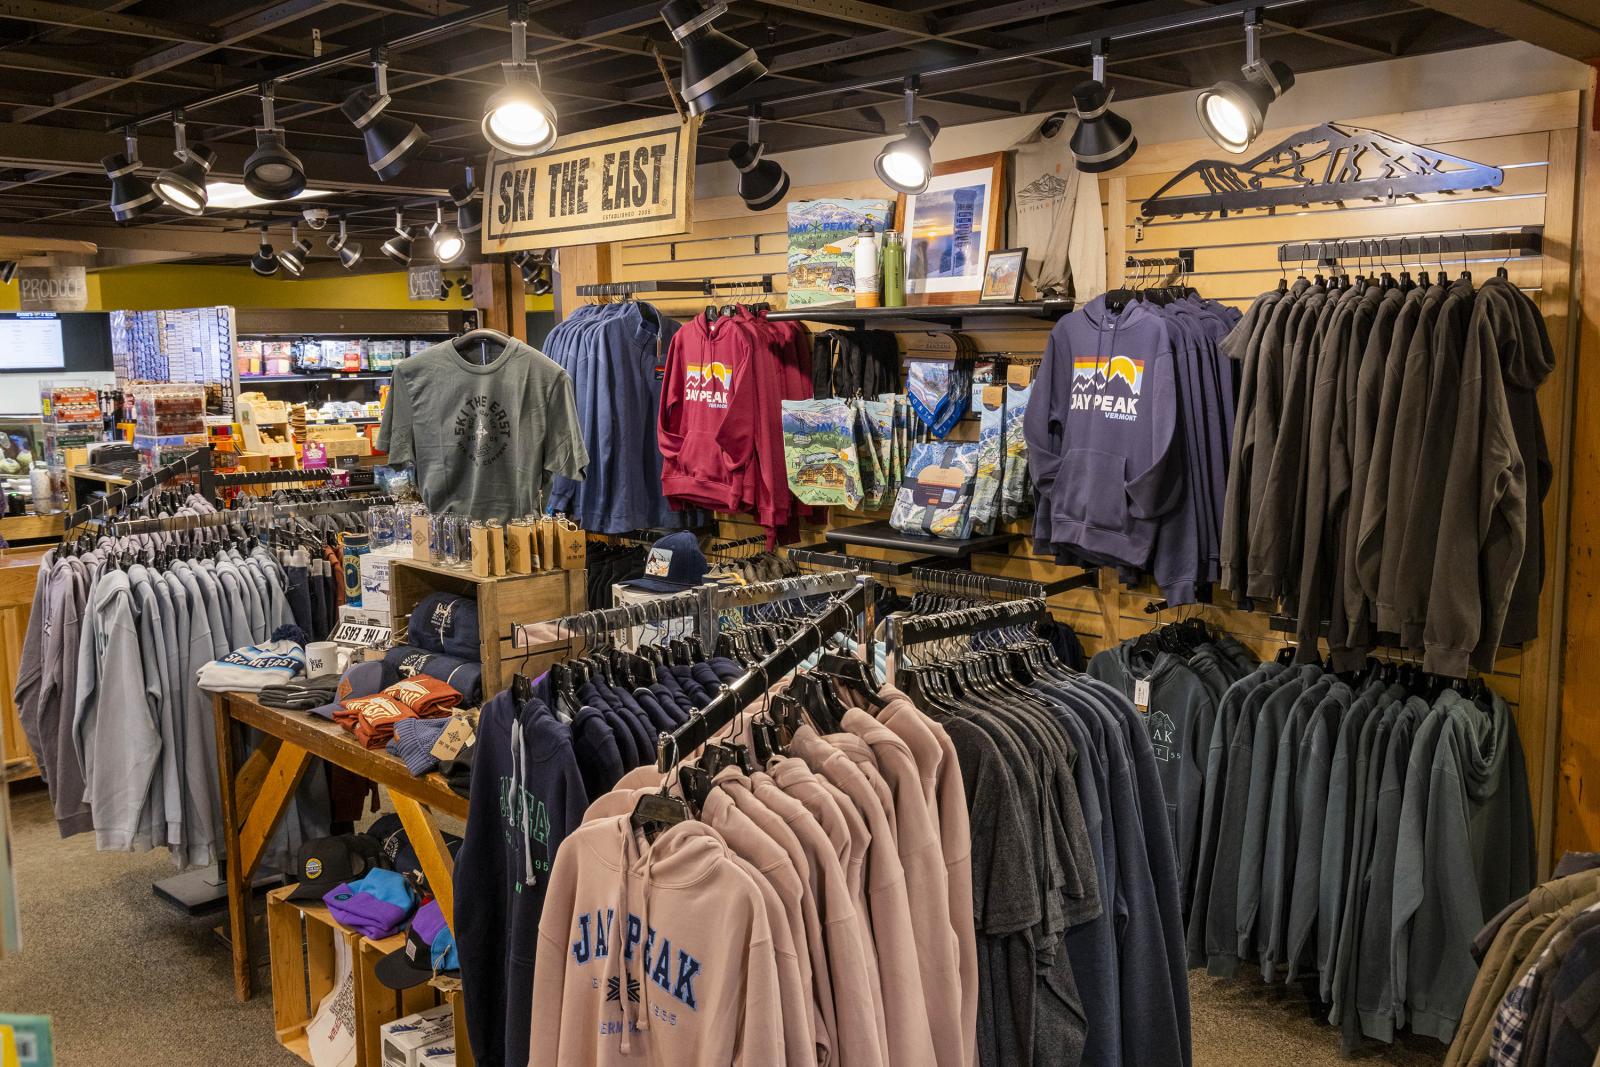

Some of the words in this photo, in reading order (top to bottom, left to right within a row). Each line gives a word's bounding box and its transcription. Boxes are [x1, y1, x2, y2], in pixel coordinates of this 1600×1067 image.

[498, 167, 537, 224] SKI
[548, 157, 590, 217] THE
[601, 144, 667, 211] EAST
[823, 221, 853, 232] PEAK
[21, 278, 82, 304] PRODUCE
[410, 270, 440, 297] CHEESE
[686, 389, 700, 401] JAY
[700, 390, 729, 405] PEAK
[1070, 393, 1092, 410] JAY
[1094, 394, 1140, 415] PEAK
[454, 409, 470, 437] SKI
[465, 395, 487, 411] THE
[489, 401, 511, 438] EAST
[1104, 411, 1138, 421] VERMONT
[816, 422, 834, 432] JAY
[335, 625, 362, 641] EAST
[265, 658, 298, 668] EAST
